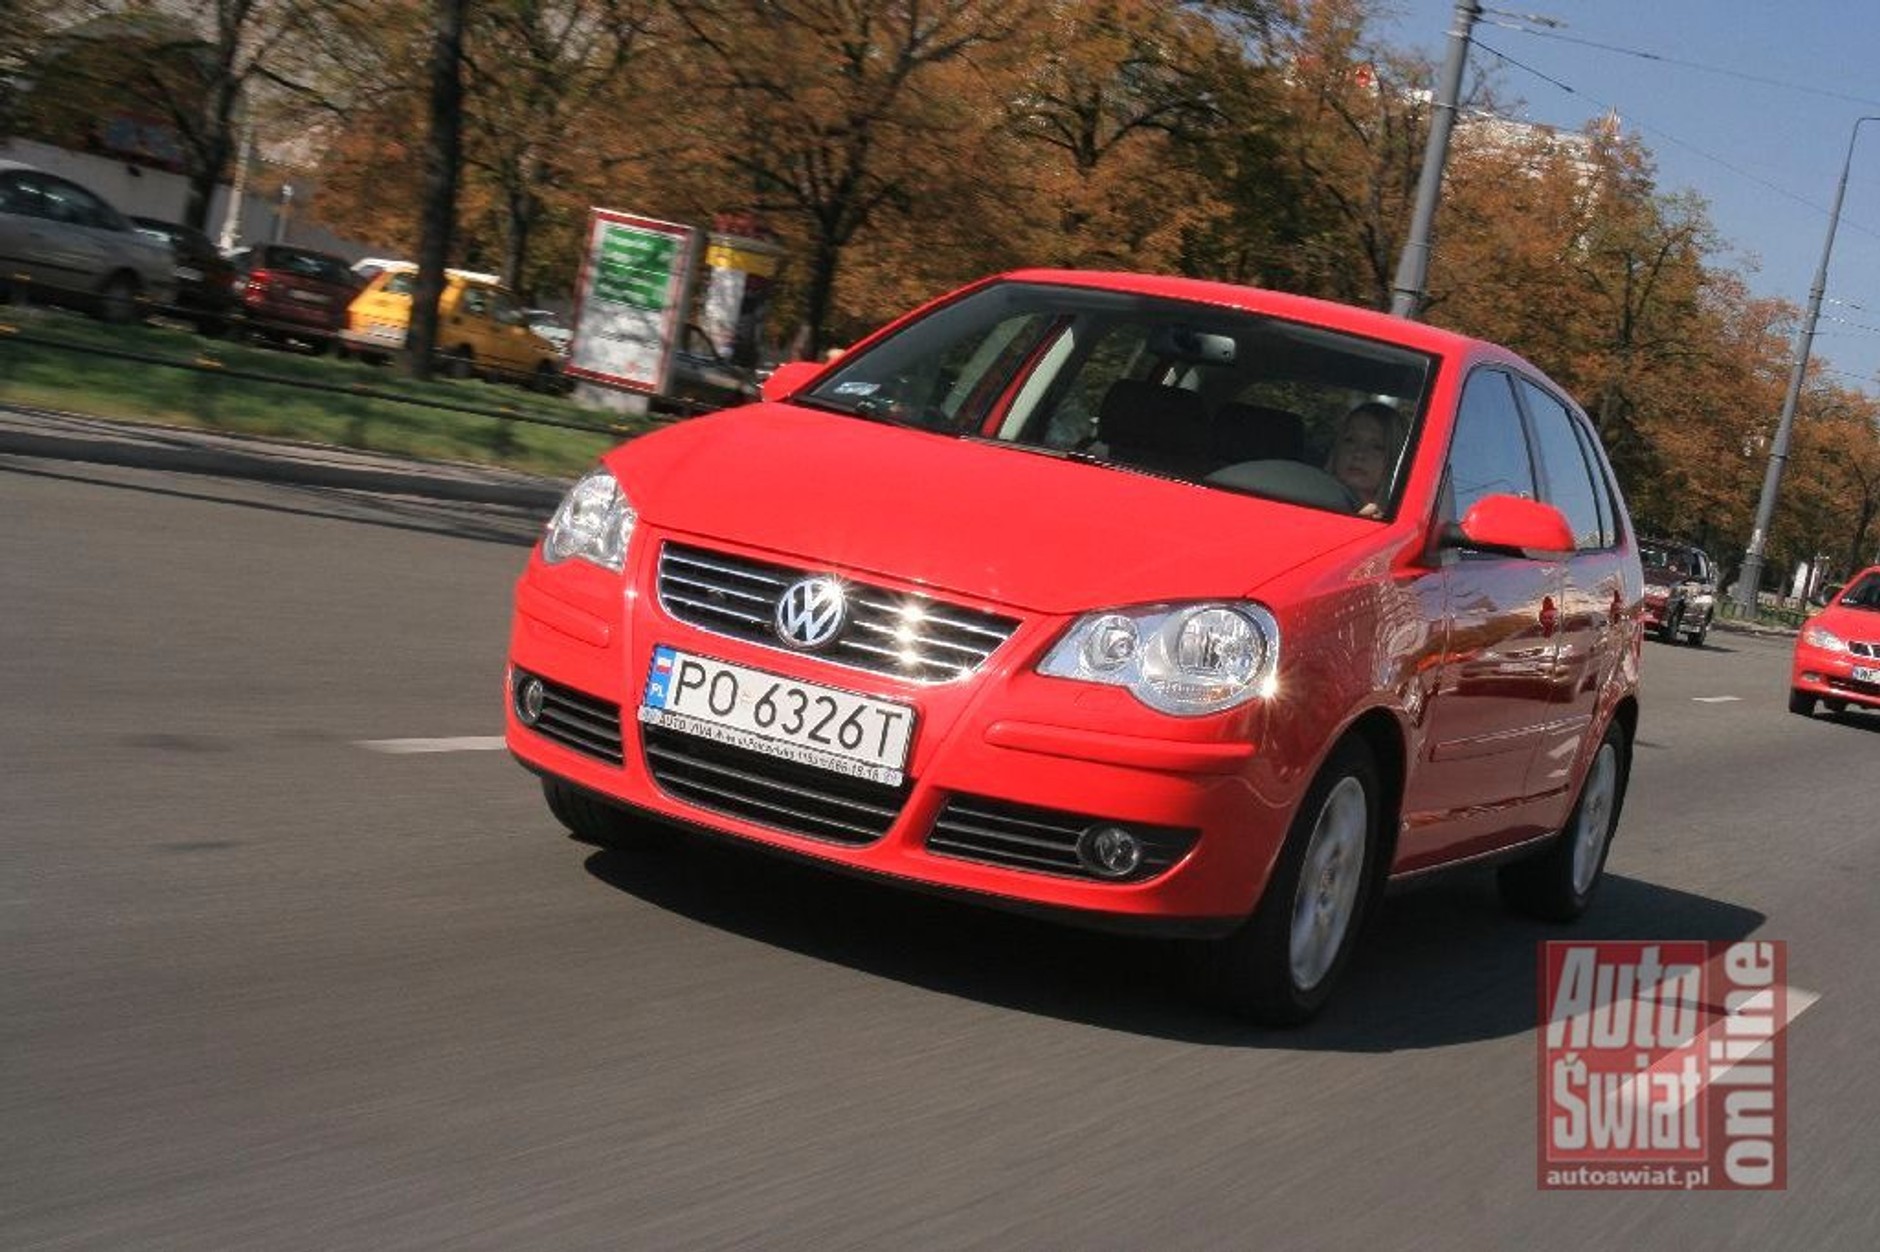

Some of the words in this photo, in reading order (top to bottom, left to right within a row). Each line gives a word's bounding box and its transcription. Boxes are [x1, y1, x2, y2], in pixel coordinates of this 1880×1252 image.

[650, 682, 665, 698] PL
[674, 660, 739, 716] PO
[754, 683, 903, 757] 6326T
